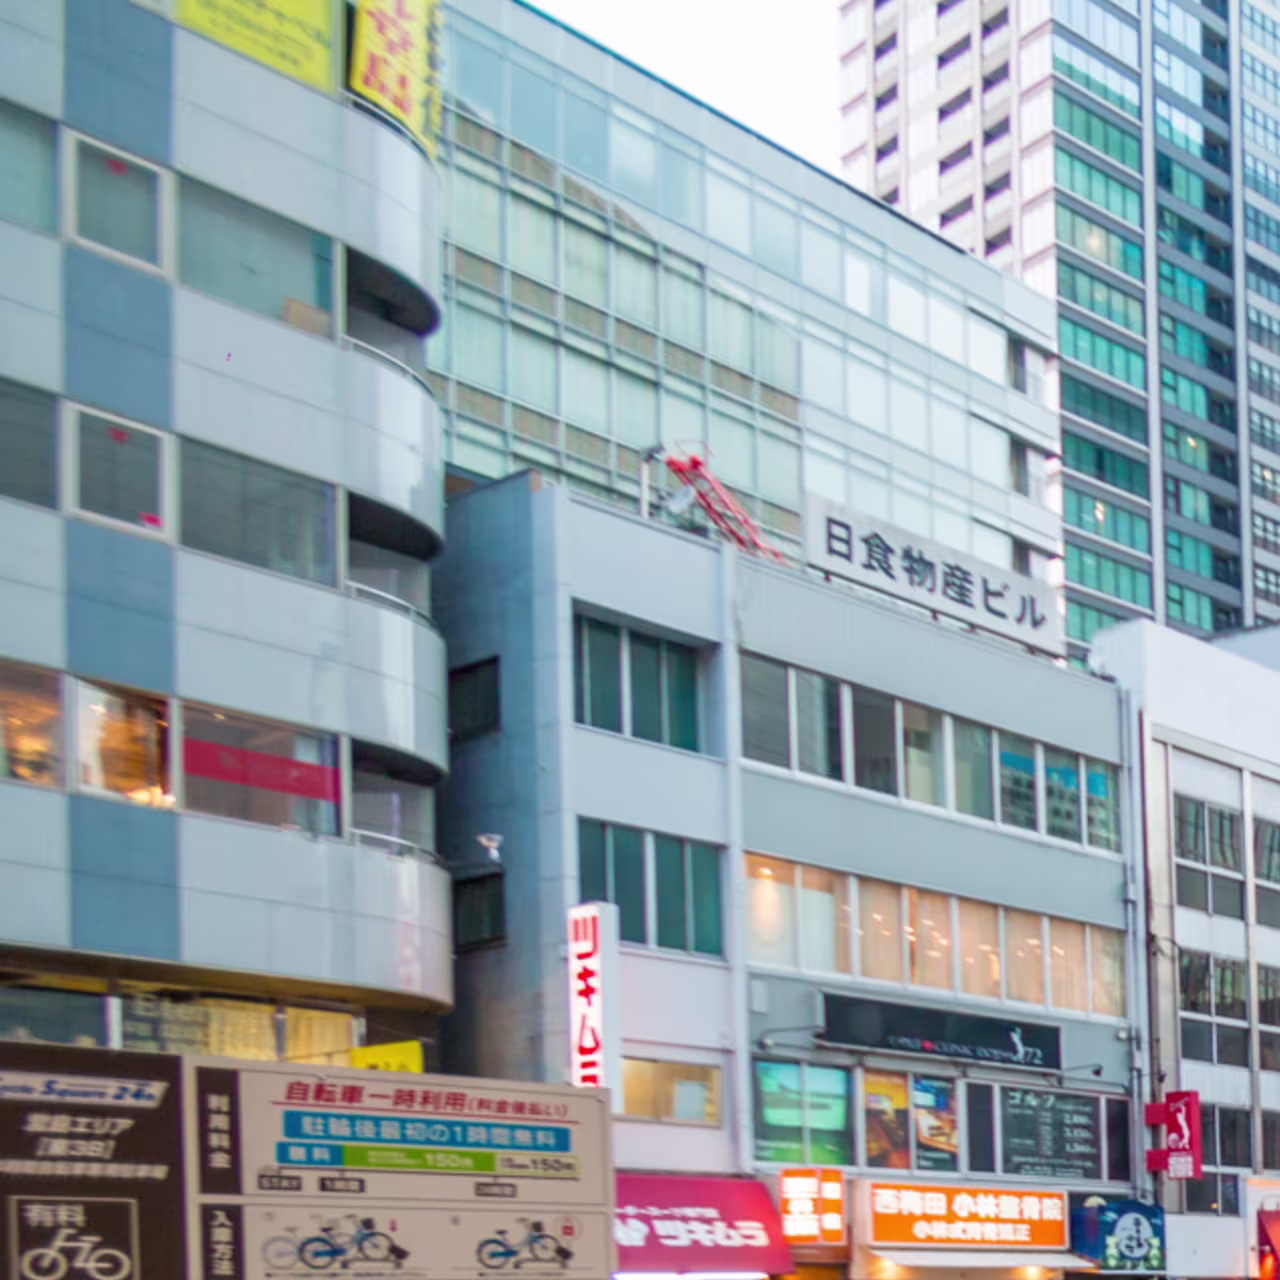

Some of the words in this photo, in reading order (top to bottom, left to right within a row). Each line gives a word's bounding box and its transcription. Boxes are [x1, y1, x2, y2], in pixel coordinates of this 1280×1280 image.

[824, 516, 1047, 632] 日食物産ビル
[873, 1188, 948, 1216] 西梅田
[951, 1192, 1063, 1221] 小林整骨院
